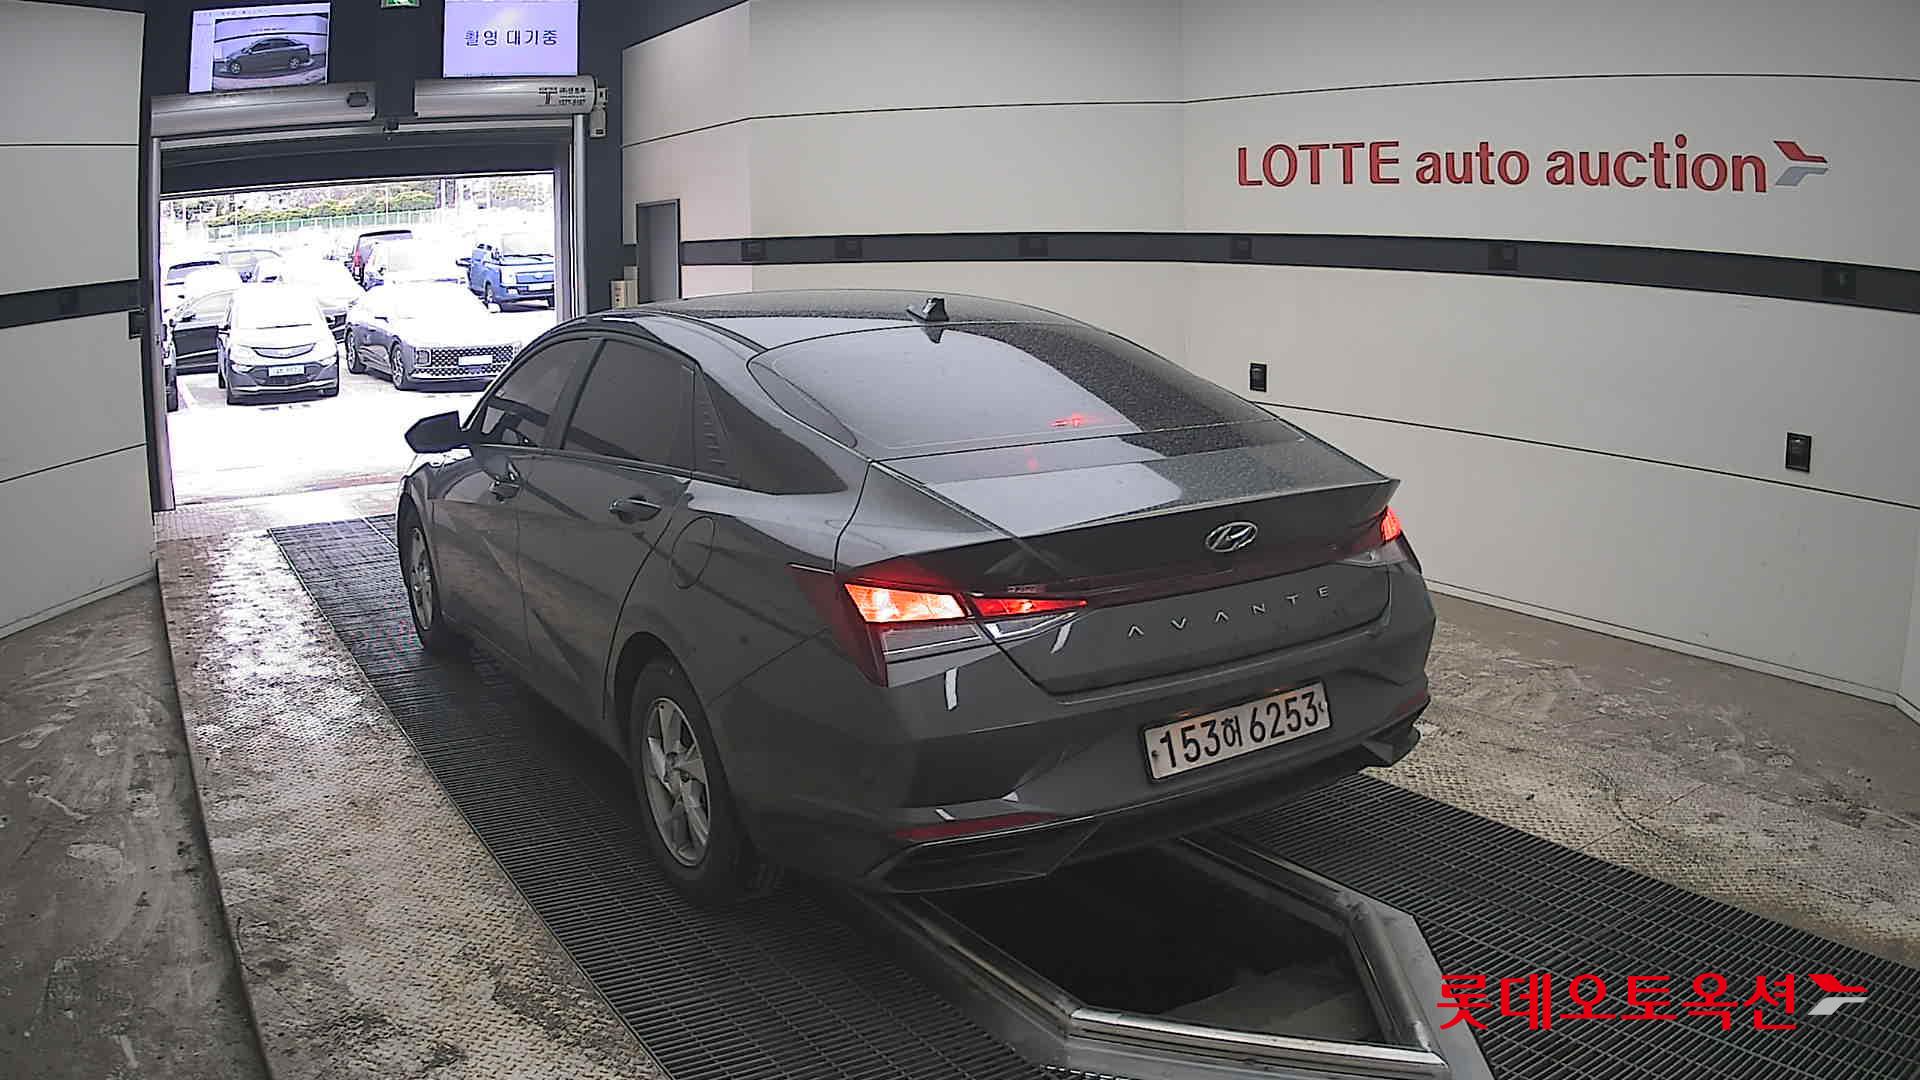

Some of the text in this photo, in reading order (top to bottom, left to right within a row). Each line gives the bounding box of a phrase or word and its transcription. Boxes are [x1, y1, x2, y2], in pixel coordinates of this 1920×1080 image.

[506, 30, 558, 46] 대기중
[1237, 134, 1767, 193] LOTTE auto auction
[1128, 585, 1329, 638] AVANTE
[1250, 691, 1319, 743] 6253
